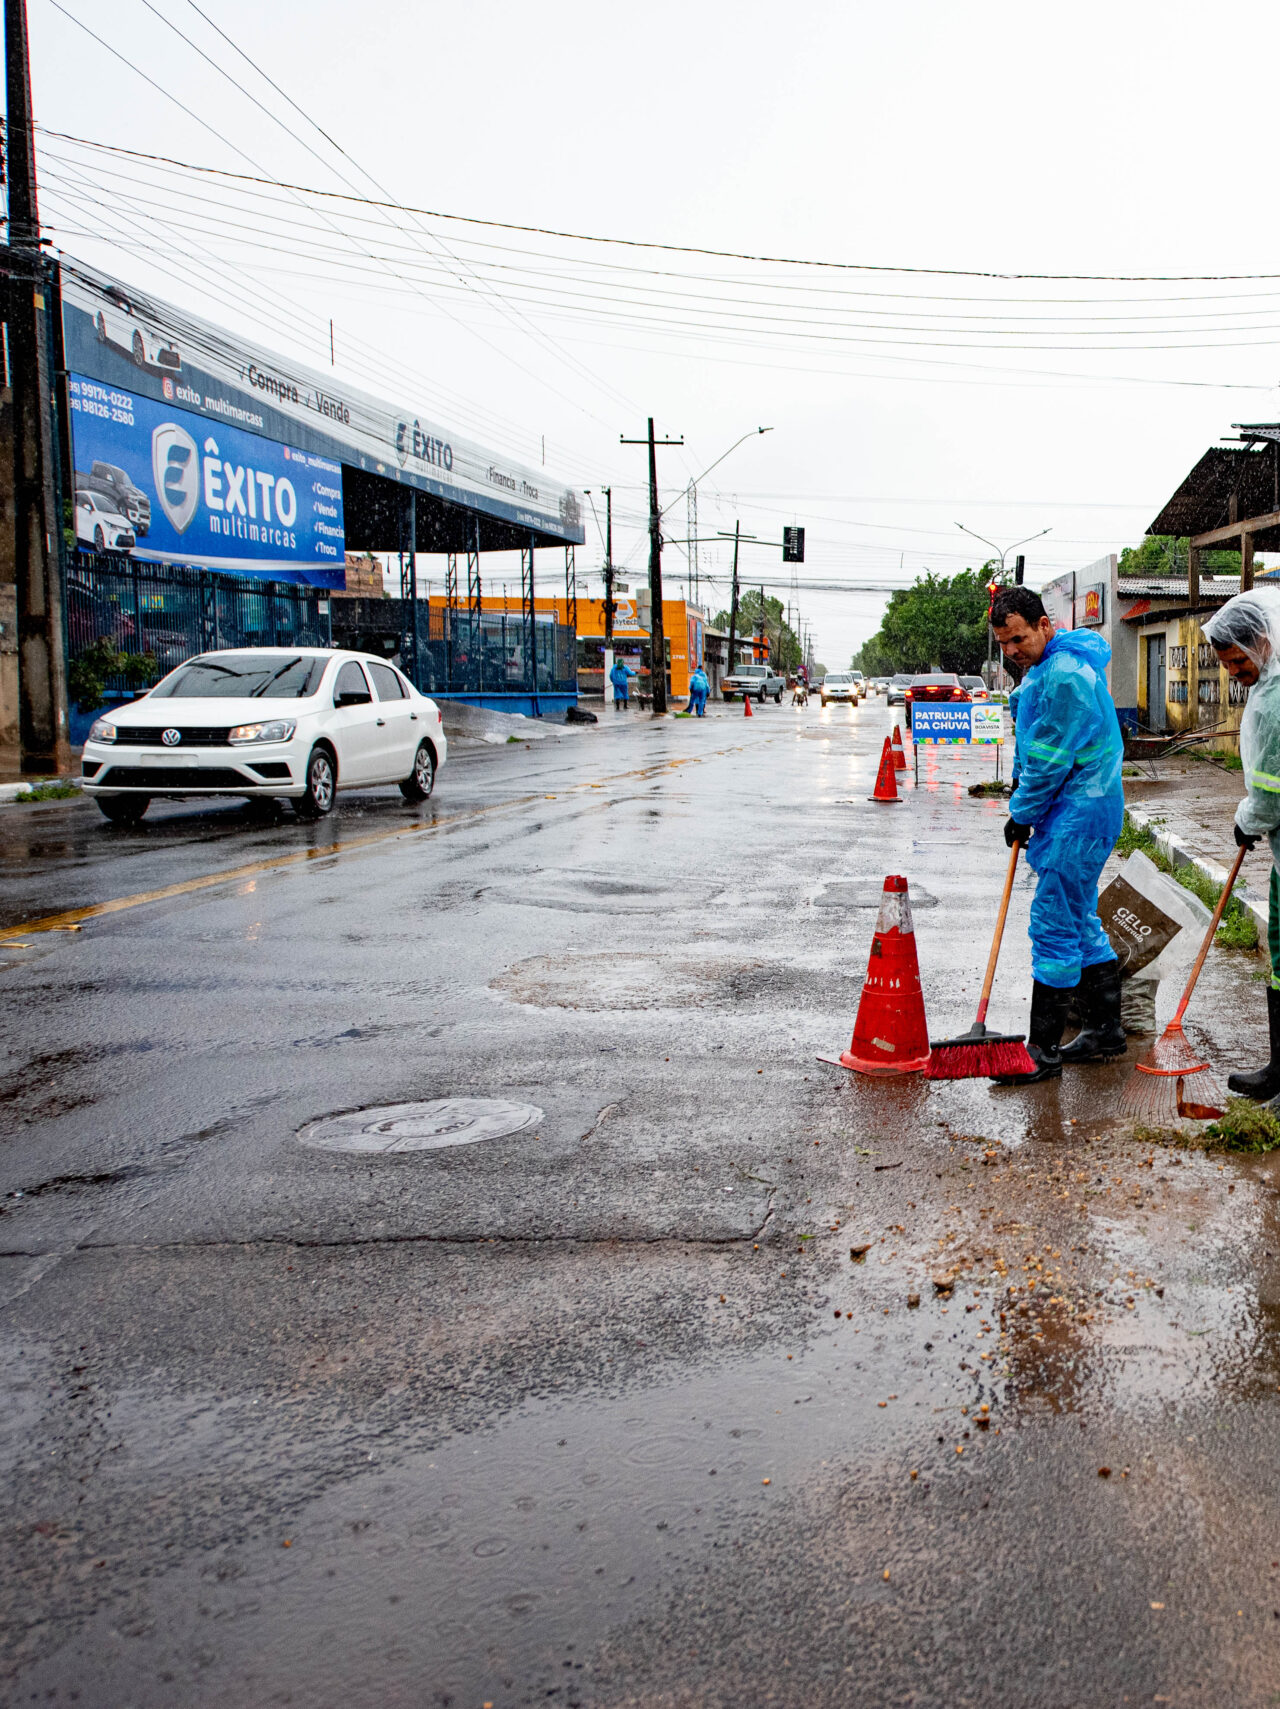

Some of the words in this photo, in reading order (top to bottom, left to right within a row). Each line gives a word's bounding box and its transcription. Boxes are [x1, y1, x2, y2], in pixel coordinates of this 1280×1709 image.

[81, 381, 134, 411] 99174-0222
[176, 384, 264, 428] exito_multimarcass
[248, 363, 299, 403] Compra
[315, 390, 350, 424] Vende
[82, 398, 135, 426] 98126-2580
[412, 419, 453, 472] ÊXITO
[203, 437, 297, 528] ÊXITO
[316, 483, 341, 501] Compra
[318, 502, 338, 518] Vende
[209, 514, 297, 549] multimarcas
[318, 522, 345, 538] Financia
[319, 541, 337, 556] Troca
[915, 711, 970, 720] PATRULHA
[915, 721, 931, 730] DA
[932, 721, 970, 730] CHUVA
[1112, 914, 1144, 943] triturado
[1116, 907, 1152, 936] GELO
